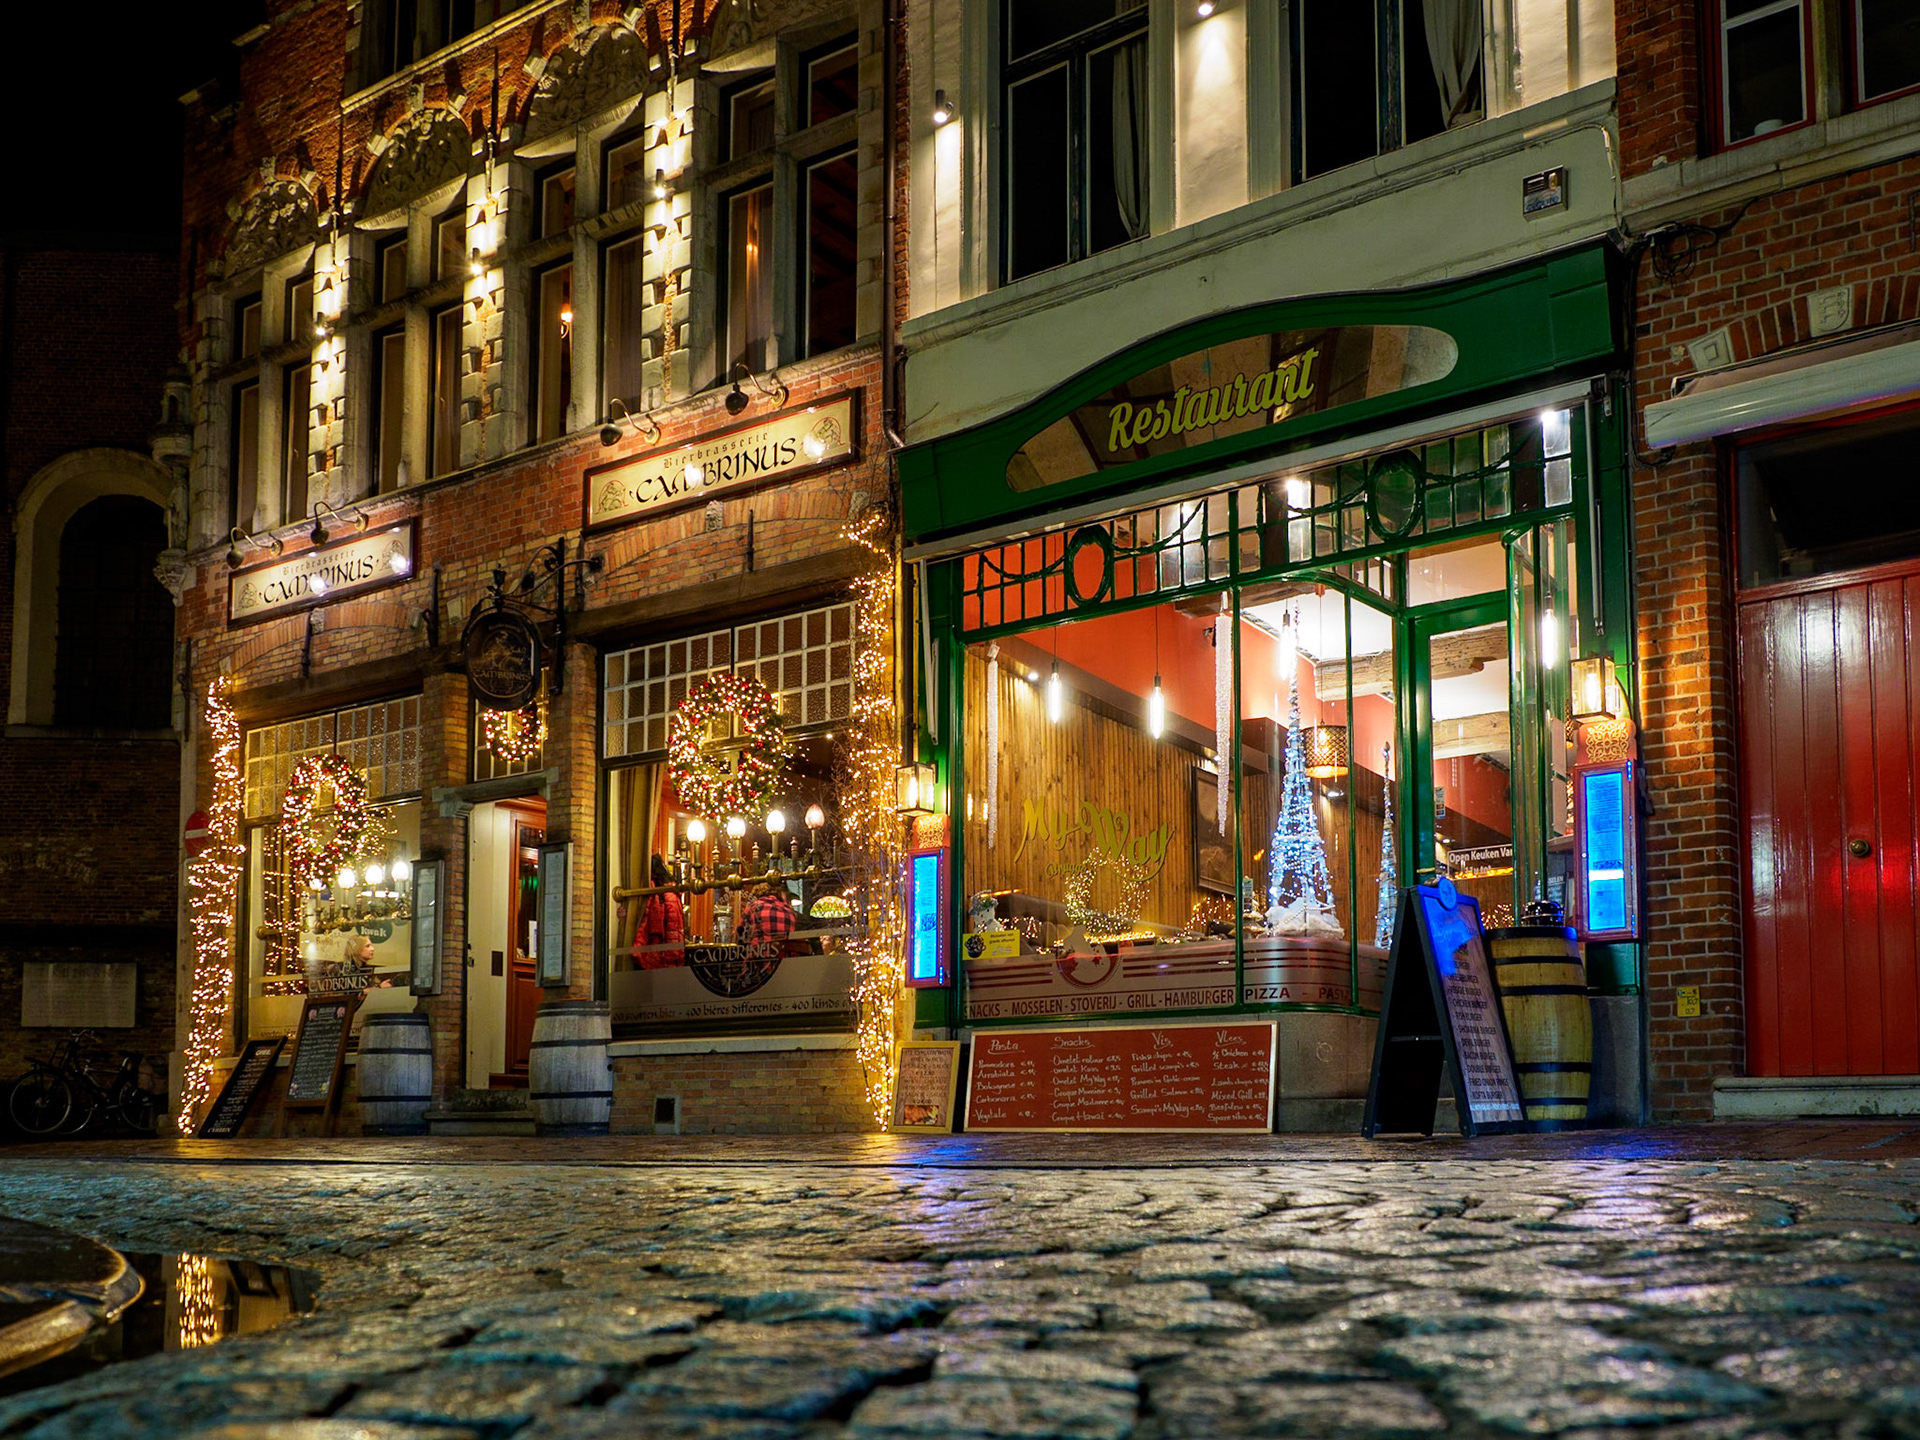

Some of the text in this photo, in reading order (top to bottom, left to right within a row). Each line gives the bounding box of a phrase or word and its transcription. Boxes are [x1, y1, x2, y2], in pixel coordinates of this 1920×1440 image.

[1108, 347, 1320, 452] Restaurant
[662, 431, 769, 469] Bierbrasserie
[282, 548, 355, 576] Bierbrasserie
[1014, 795, 1176, 882] My Way
[1449, 853, 1470, 864] Open
[1471, 849, 1500, 861] Keuken
[693, 942, 780, 964] CAMBRINUS
[791, 1000, 809, 1011] 400
[812, 997, 840, 1009] kinds
[1011, 999, 1063, 1016] MOSSELEN
[1070, 996, 1117, 1012] STOVERIJ
[1127, 993, 1156, 1009] GRILL
[1164, 989, 1234, 1007] HAMBURGER
[1245, 987, 1291, 1000] PIZZA
[1054, 1035, 1091, 1047] Snacks
[1216, 1030, 1243, 1043] Vlees
[990, 1039, 1020, 1051] Pasta
[1131, 1062, 1157, 1073] Grilled
[1213, 1061, 1240, 1070] Steak
[976, 1081, 1016, 1094] Bolognese
[1080, 1073, 1093, 1086] My
[1093, 1074, 1106, 1088] Way
[1130, 1087, 1157, 1100] Grilled
[1211, 1090, 1237, 1100] Mixed
